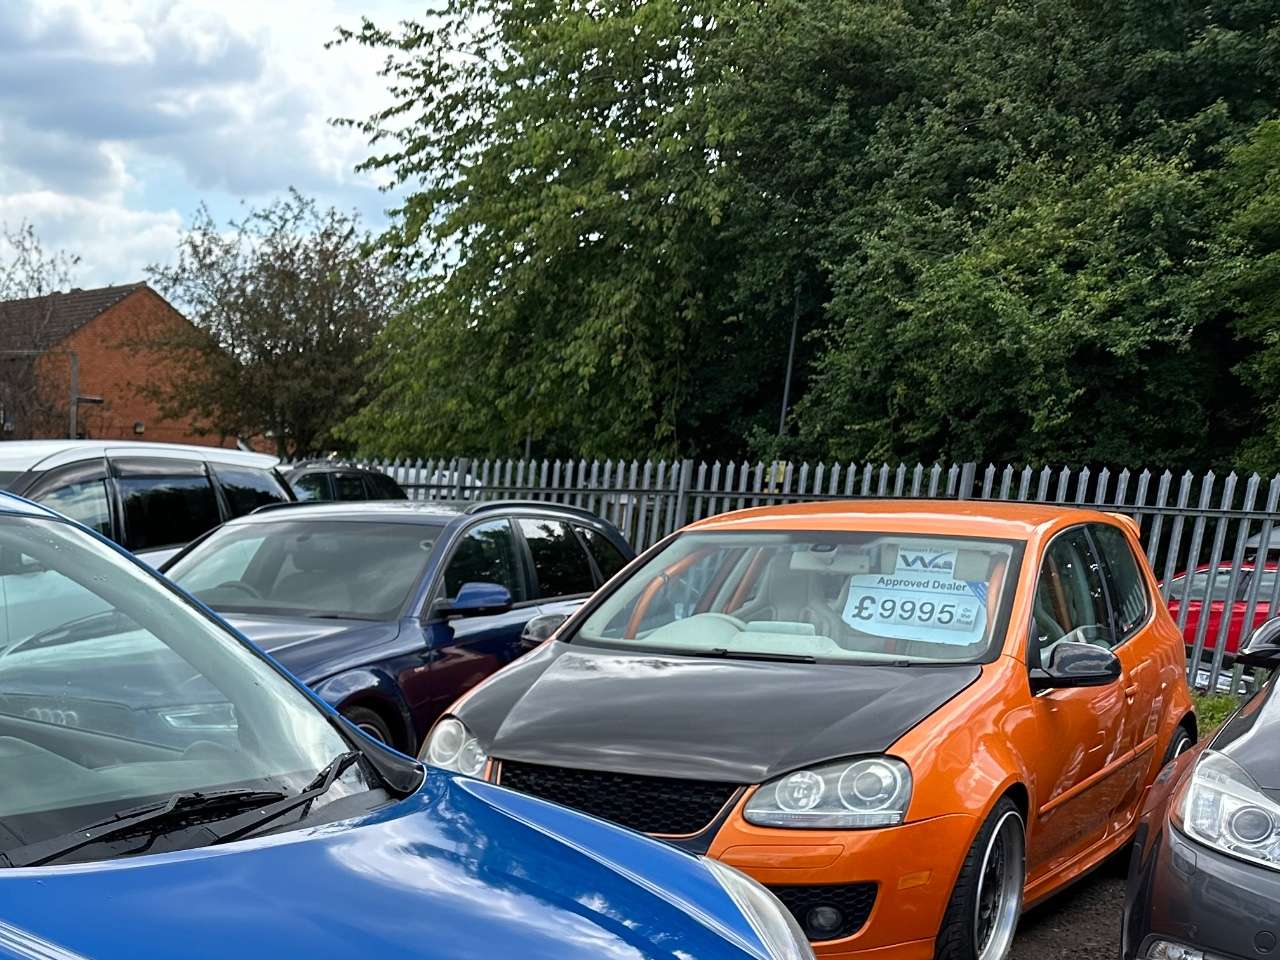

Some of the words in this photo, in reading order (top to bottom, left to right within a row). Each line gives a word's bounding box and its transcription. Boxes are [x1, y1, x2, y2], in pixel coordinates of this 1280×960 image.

[877, 576, 929, 589] Approved
[932, 580, 967, 592] Dealer
[852, 595, 956, 624] £9995
